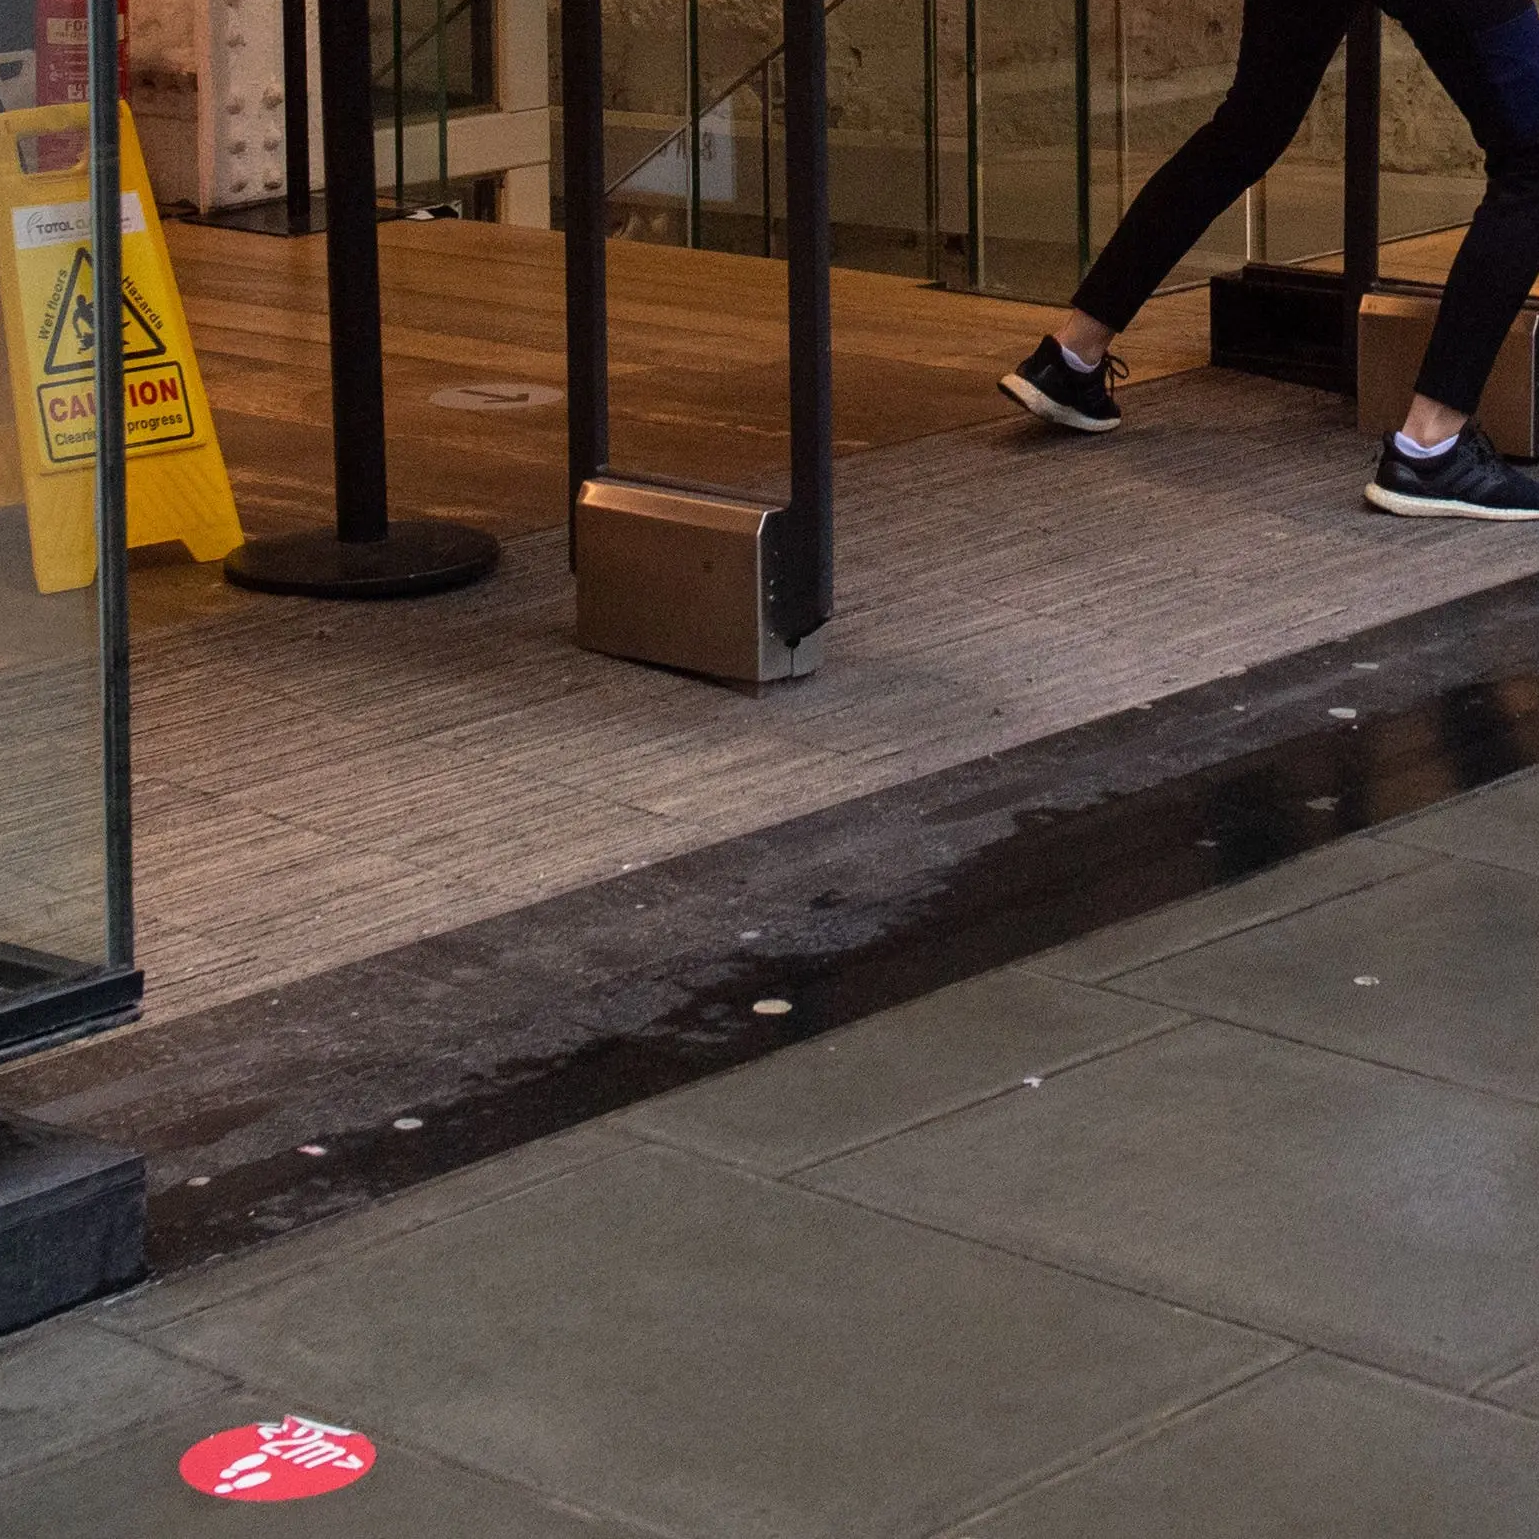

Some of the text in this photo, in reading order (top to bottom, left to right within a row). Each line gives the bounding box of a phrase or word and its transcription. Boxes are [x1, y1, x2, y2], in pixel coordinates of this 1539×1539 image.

[38, 269, 68, 340] Wet floors
[121, 275, 164, 330] Hazards
[49, 377, 180, 423] CAION
[127, 413, 183, 434] progress
